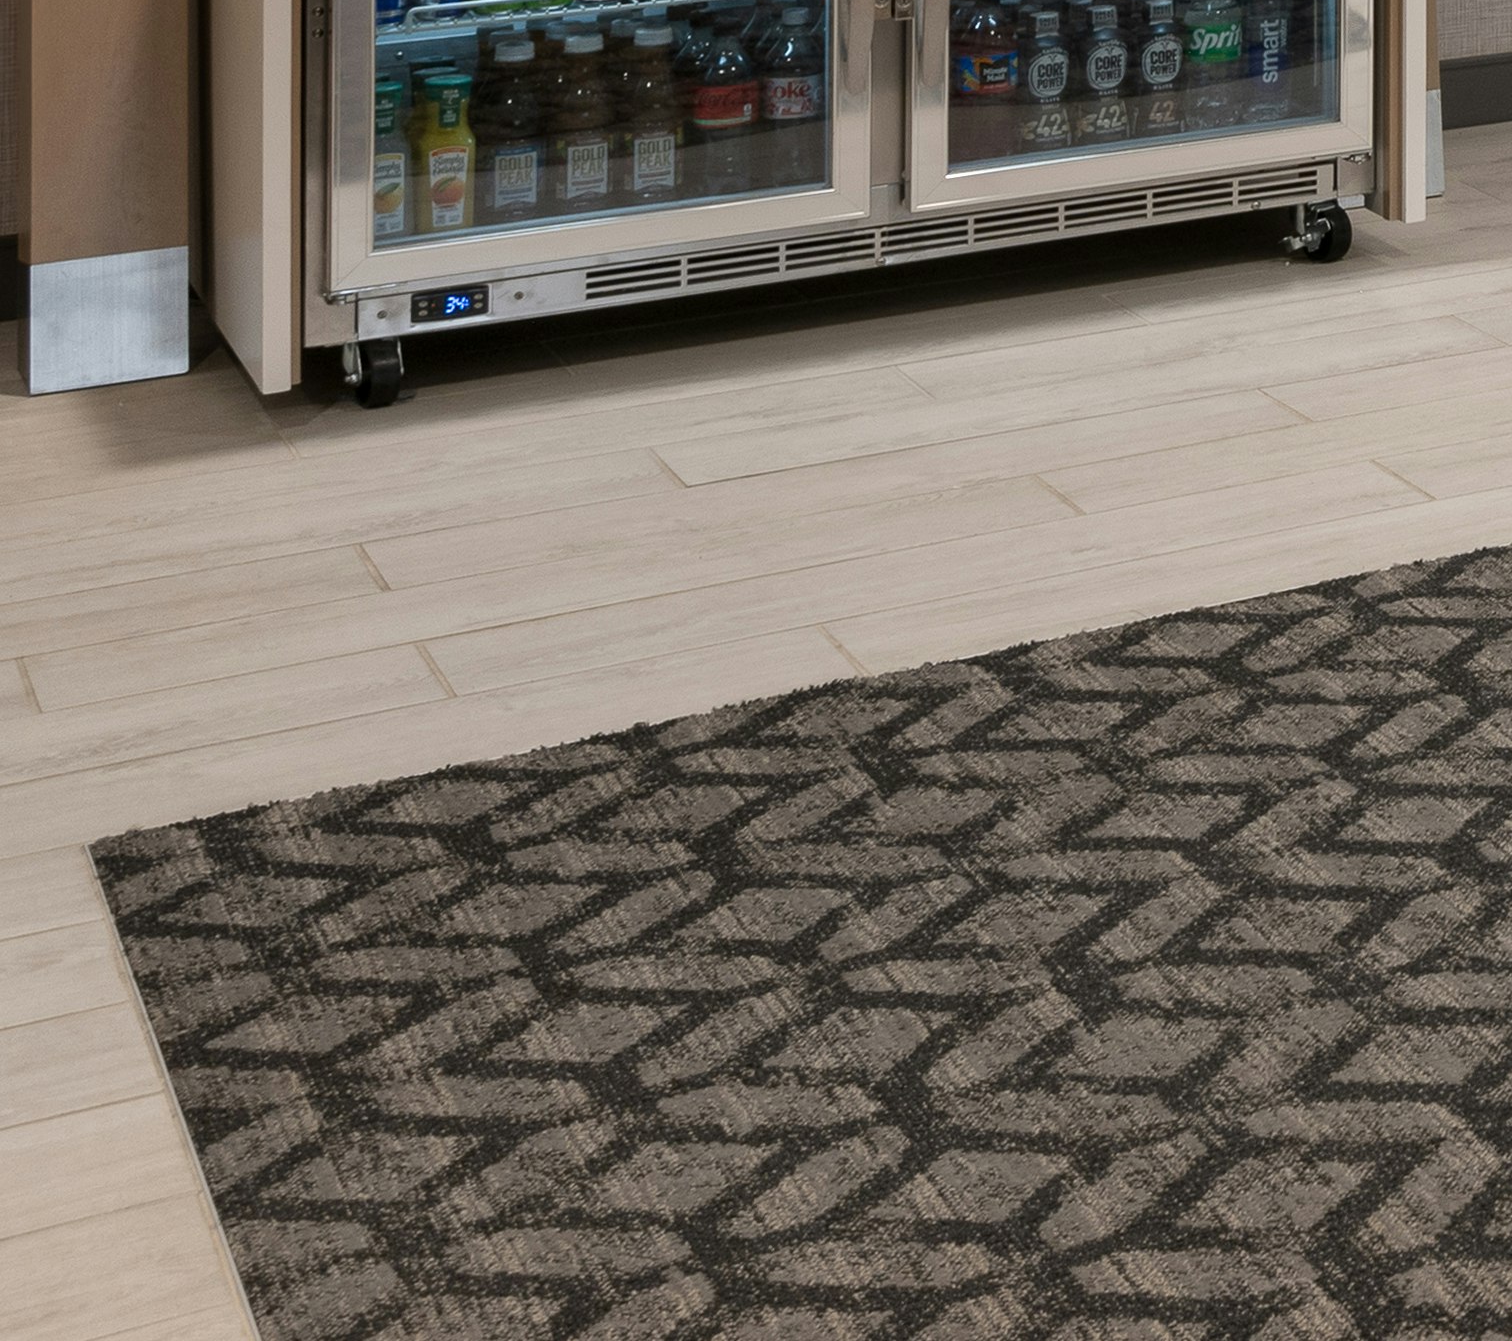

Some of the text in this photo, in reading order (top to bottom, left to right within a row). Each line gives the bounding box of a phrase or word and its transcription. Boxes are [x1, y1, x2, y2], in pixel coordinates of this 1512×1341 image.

[1150, 48, 1178, 65] CORE
[1260, 18, 1280, 84] smart
[1037, 61, 1065, 78] CORE
[1095, 53, 1123, 71] CORE
[1149, 64, 1177, 76] POWER
[1037, 77, 1064, 90] POWER
[1095, 69, 1122, 82] POWER
[572, 145, 605, 163] GOLD
[638, 138, 671, 155] GOLD
[499, 154, 533, 171] GOLD
[572, 160, 605, 175] PEAK
[639, 153, 671, 167] PEAK
[500, 169, 533, 186] PEAK
